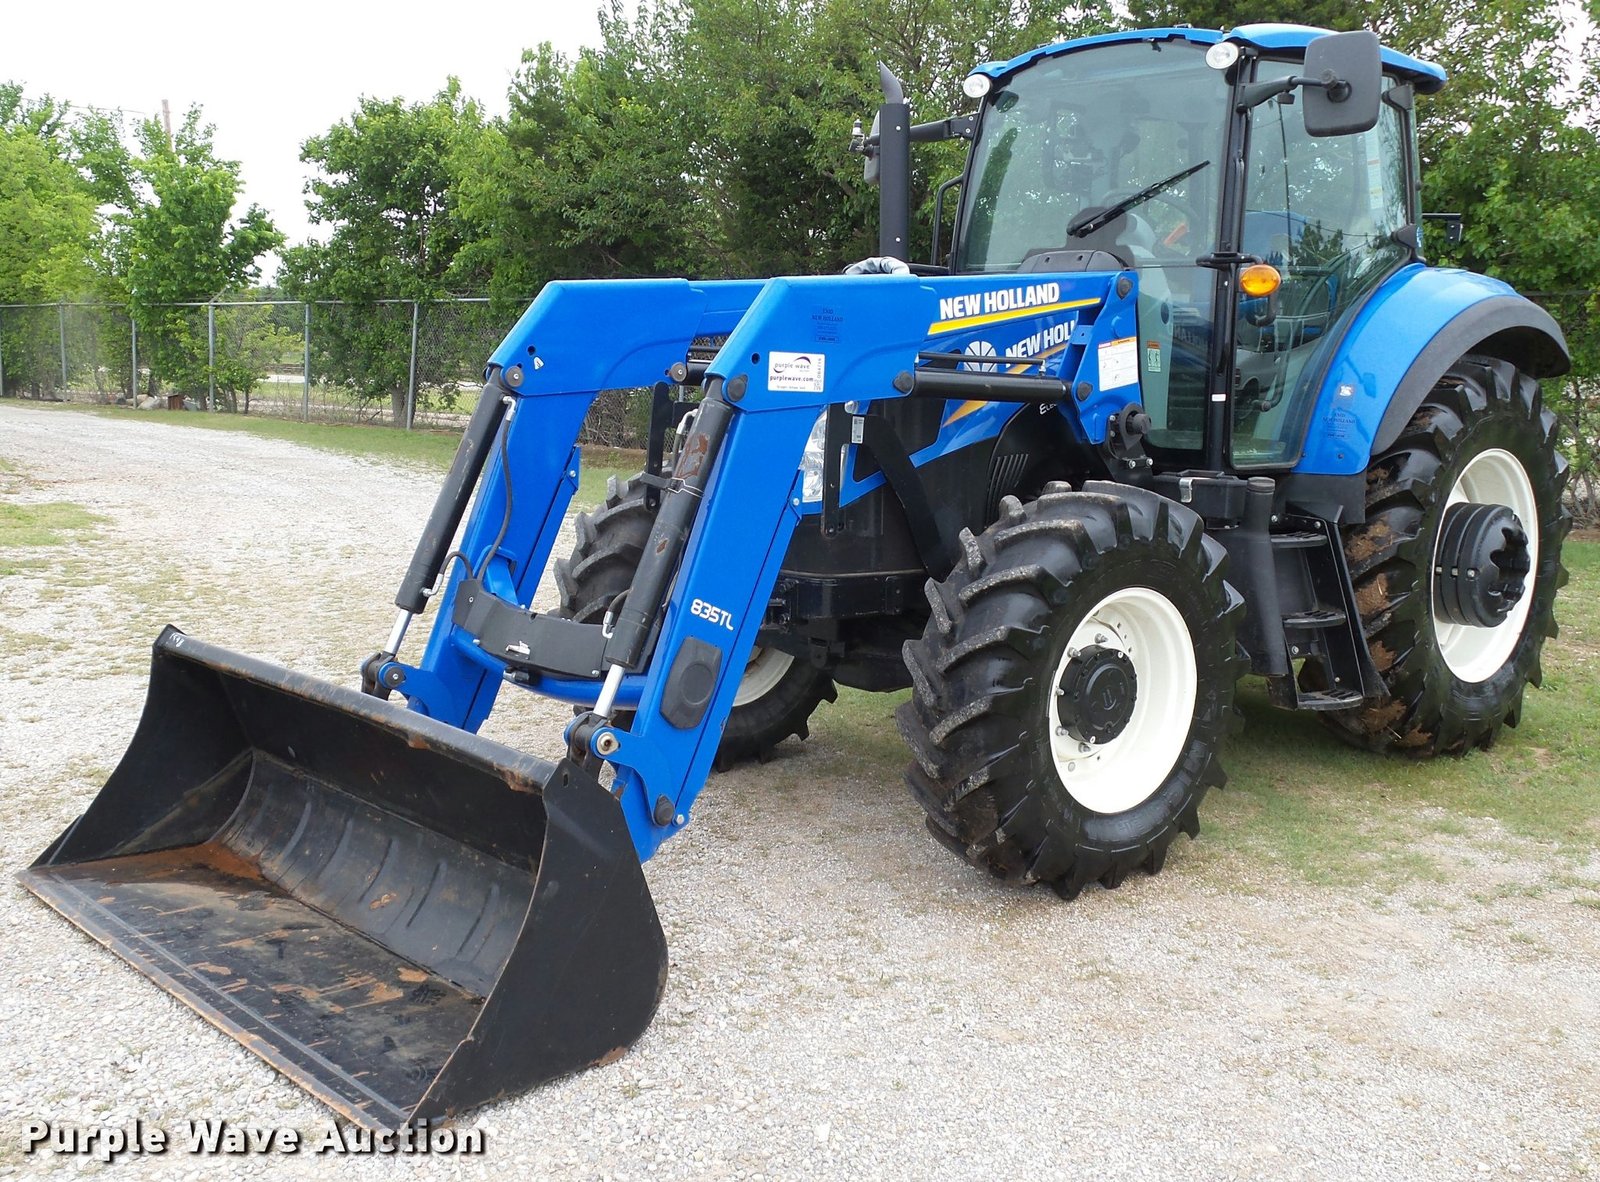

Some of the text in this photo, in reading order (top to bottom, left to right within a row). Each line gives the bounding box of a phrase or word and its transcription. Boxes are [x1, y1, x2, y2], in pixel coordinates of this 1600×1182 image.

[939, 282, 1060, 320] NEW HOLLAND
[1005, 333, 1041, 368] NEW
[690, 598, 734, 631] 835TL
